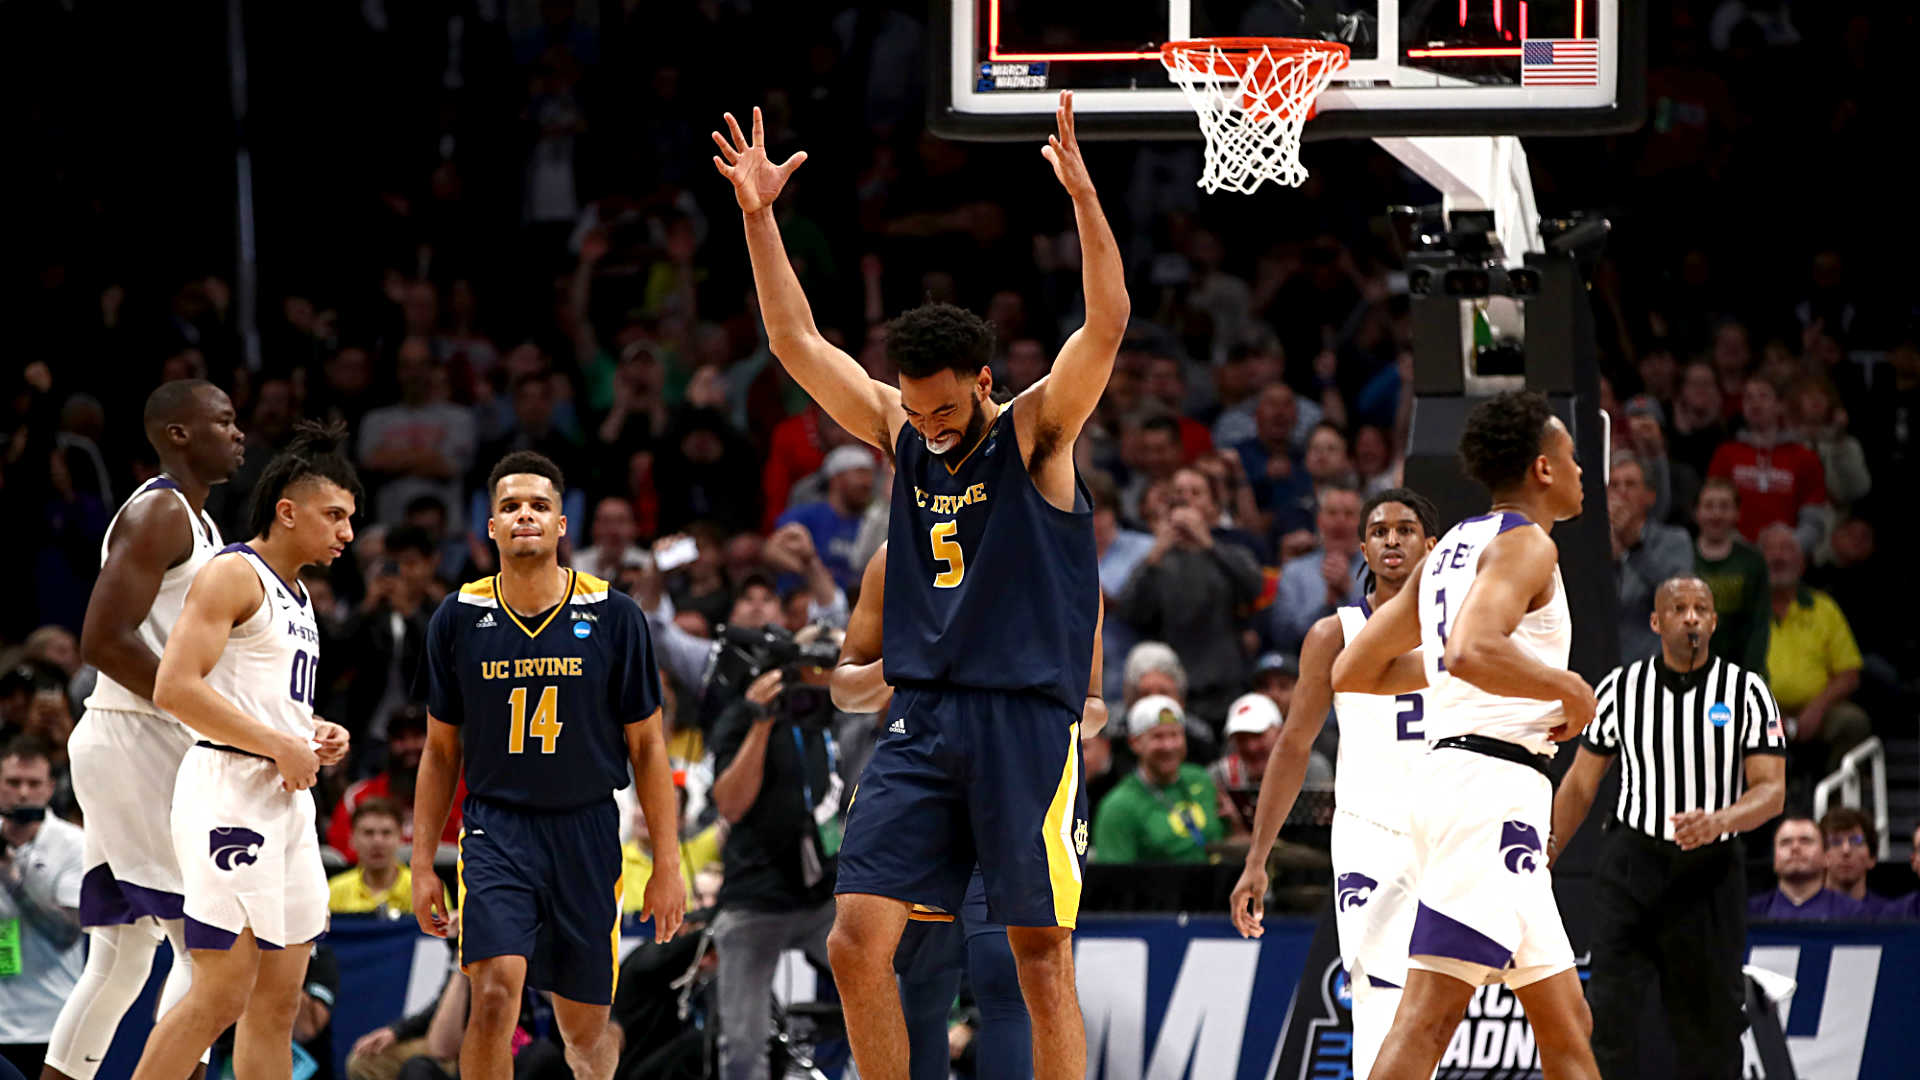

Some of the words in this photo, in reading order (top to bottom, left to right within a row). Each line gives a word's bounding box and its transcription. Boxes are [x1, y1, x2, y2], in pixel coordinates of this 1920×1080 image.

[930, 520, 964, 588] 5
[481, 660, 509, 679] UC
[514, 657, 582, 678] IRVINE
[508, 686, 563, 753] 14
